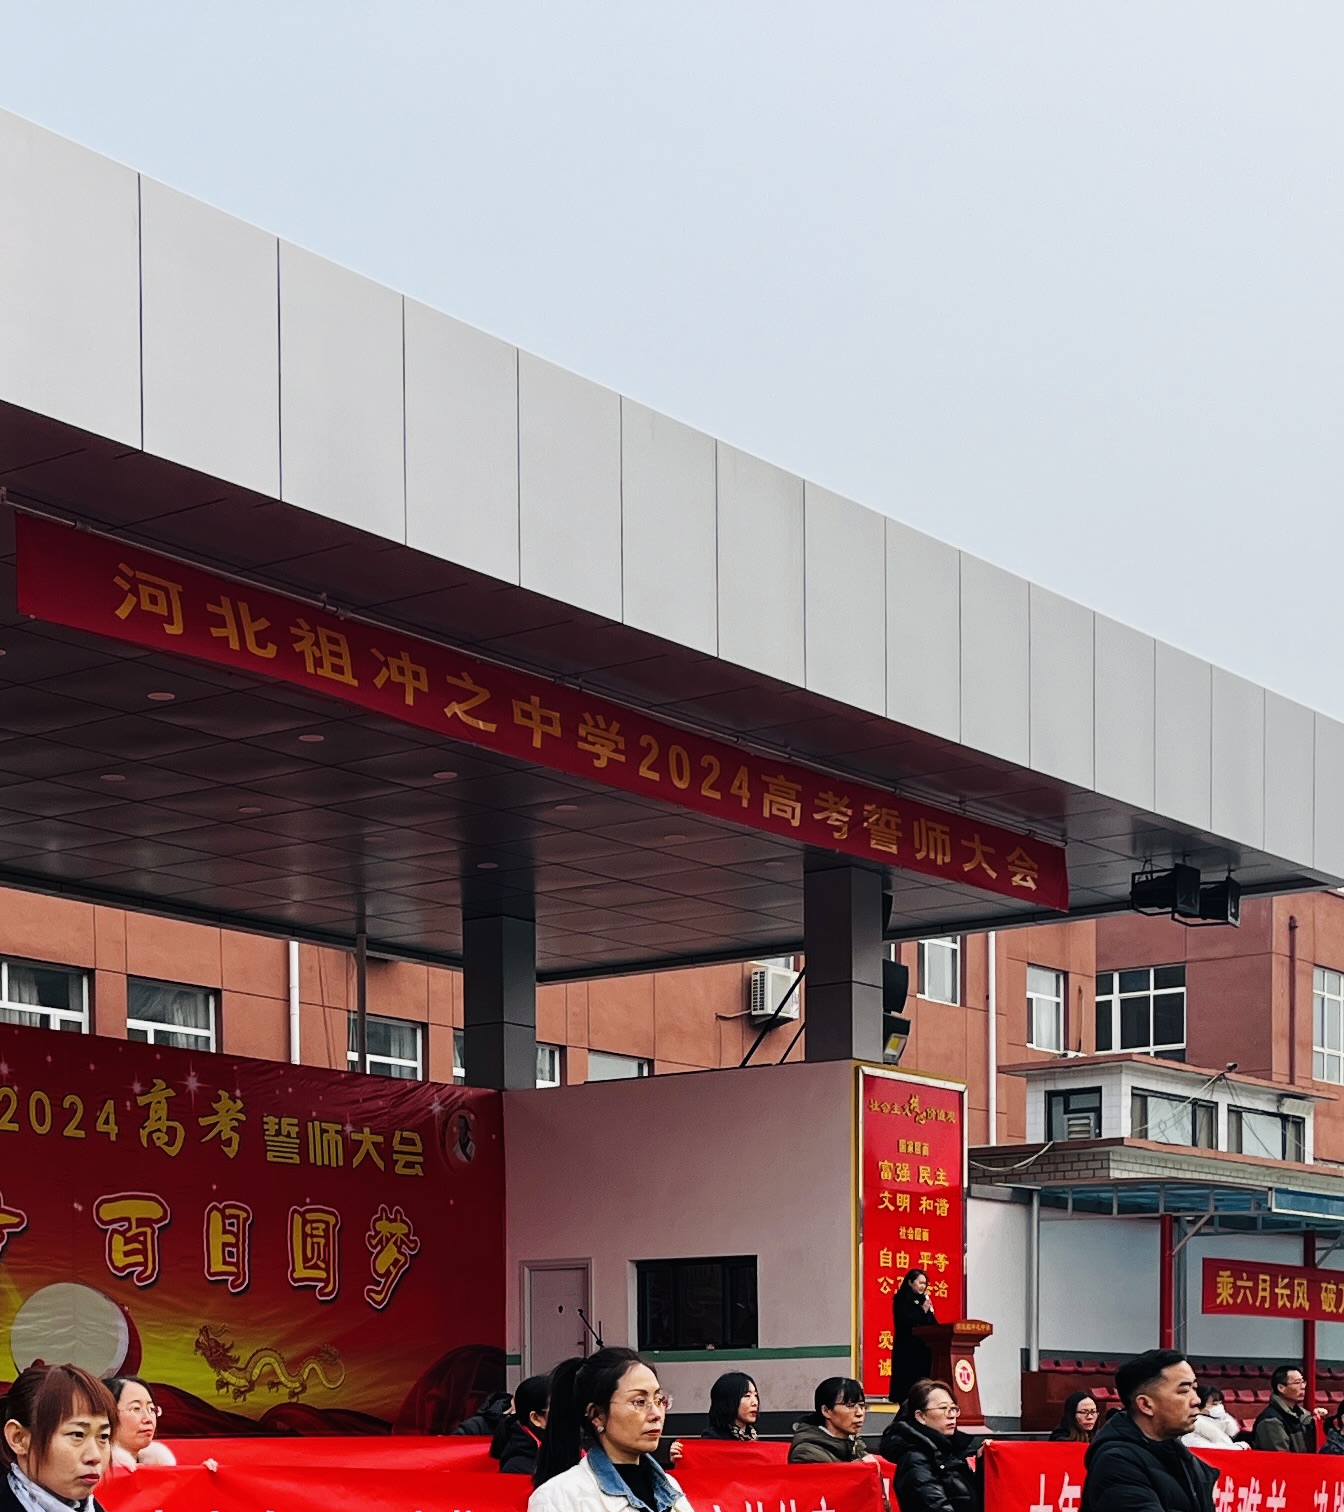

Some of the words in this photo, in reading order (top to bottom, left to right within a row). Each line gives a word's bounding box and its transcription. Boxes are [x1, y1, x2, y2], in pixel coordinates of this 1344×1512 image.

[113, 562, 1040, 893] 河北祖冲之中学2024高考誓师大会
[878, 1160, 910, 1183] 富强
[918, 1165, 950, 1187] 民主
[878, 1191, 911, 1213] 文明
[919, 1195, 950, 1217] 和谐
[93, 1191, 420, 1310] 百日圆梦
[879, 1247, 910, 1269] 自由
[918, 1251, 949, 1273] 平等
[1216, 1270, 1309, 1311] 乘六月长风
